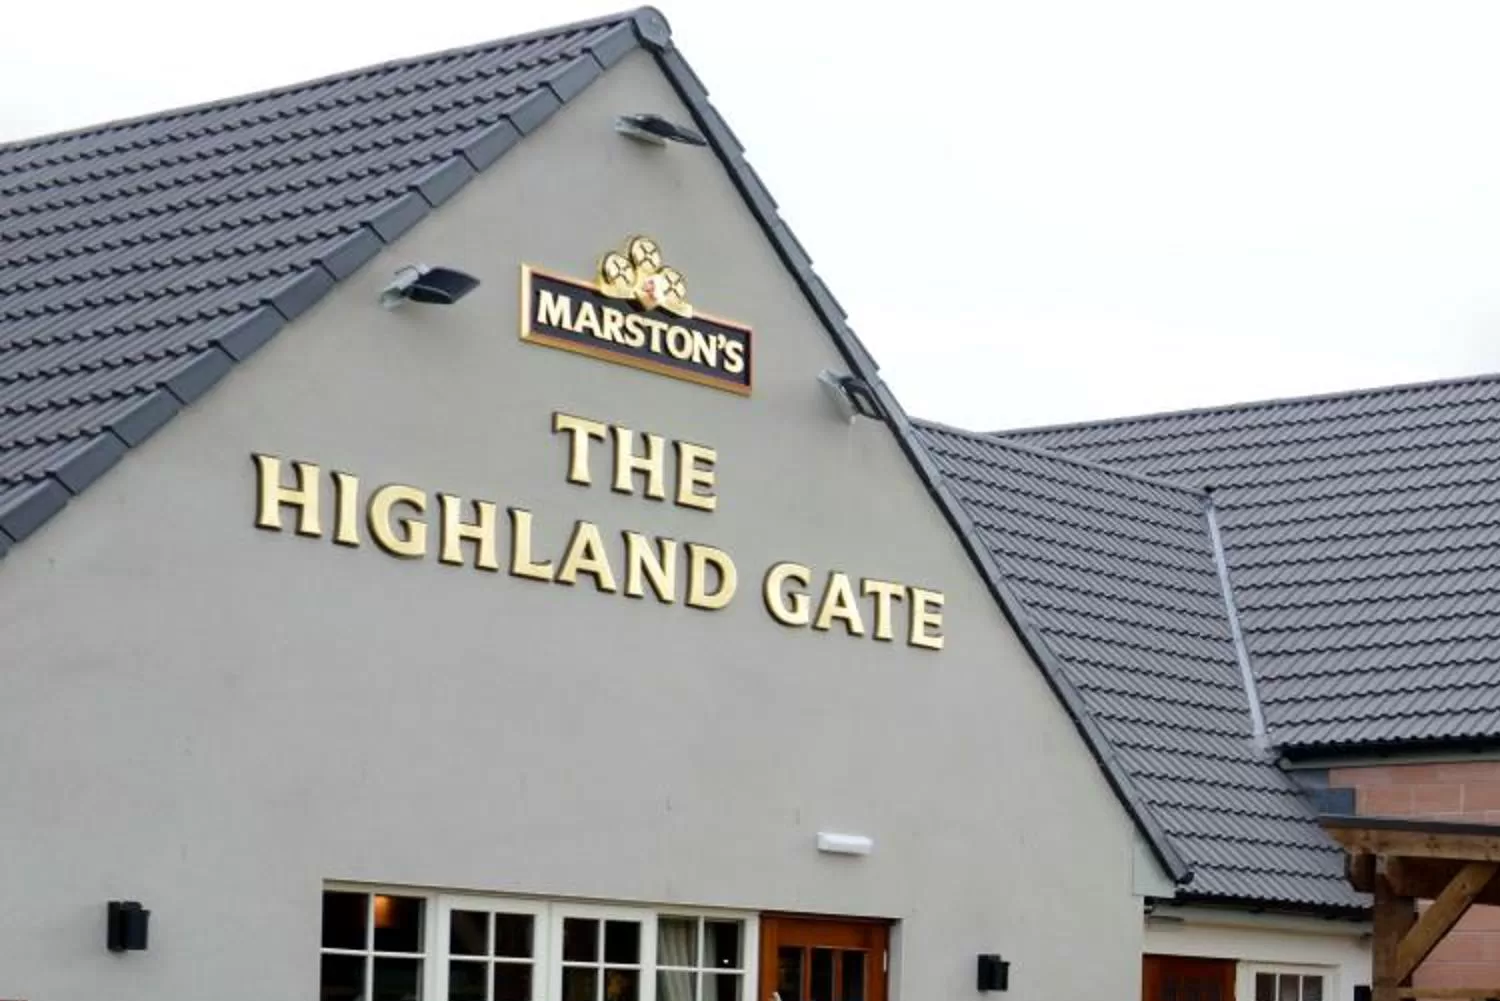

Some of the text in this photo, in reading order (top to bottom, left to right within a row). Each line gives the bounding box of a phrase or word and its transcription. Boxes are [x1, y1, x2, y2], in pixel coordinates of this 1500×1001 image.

[535, 289, 745, 375] MARSTON'S
[552, 411, 718, 512] THE
[250, 452, 945, 650] HIGHLAND GATE
